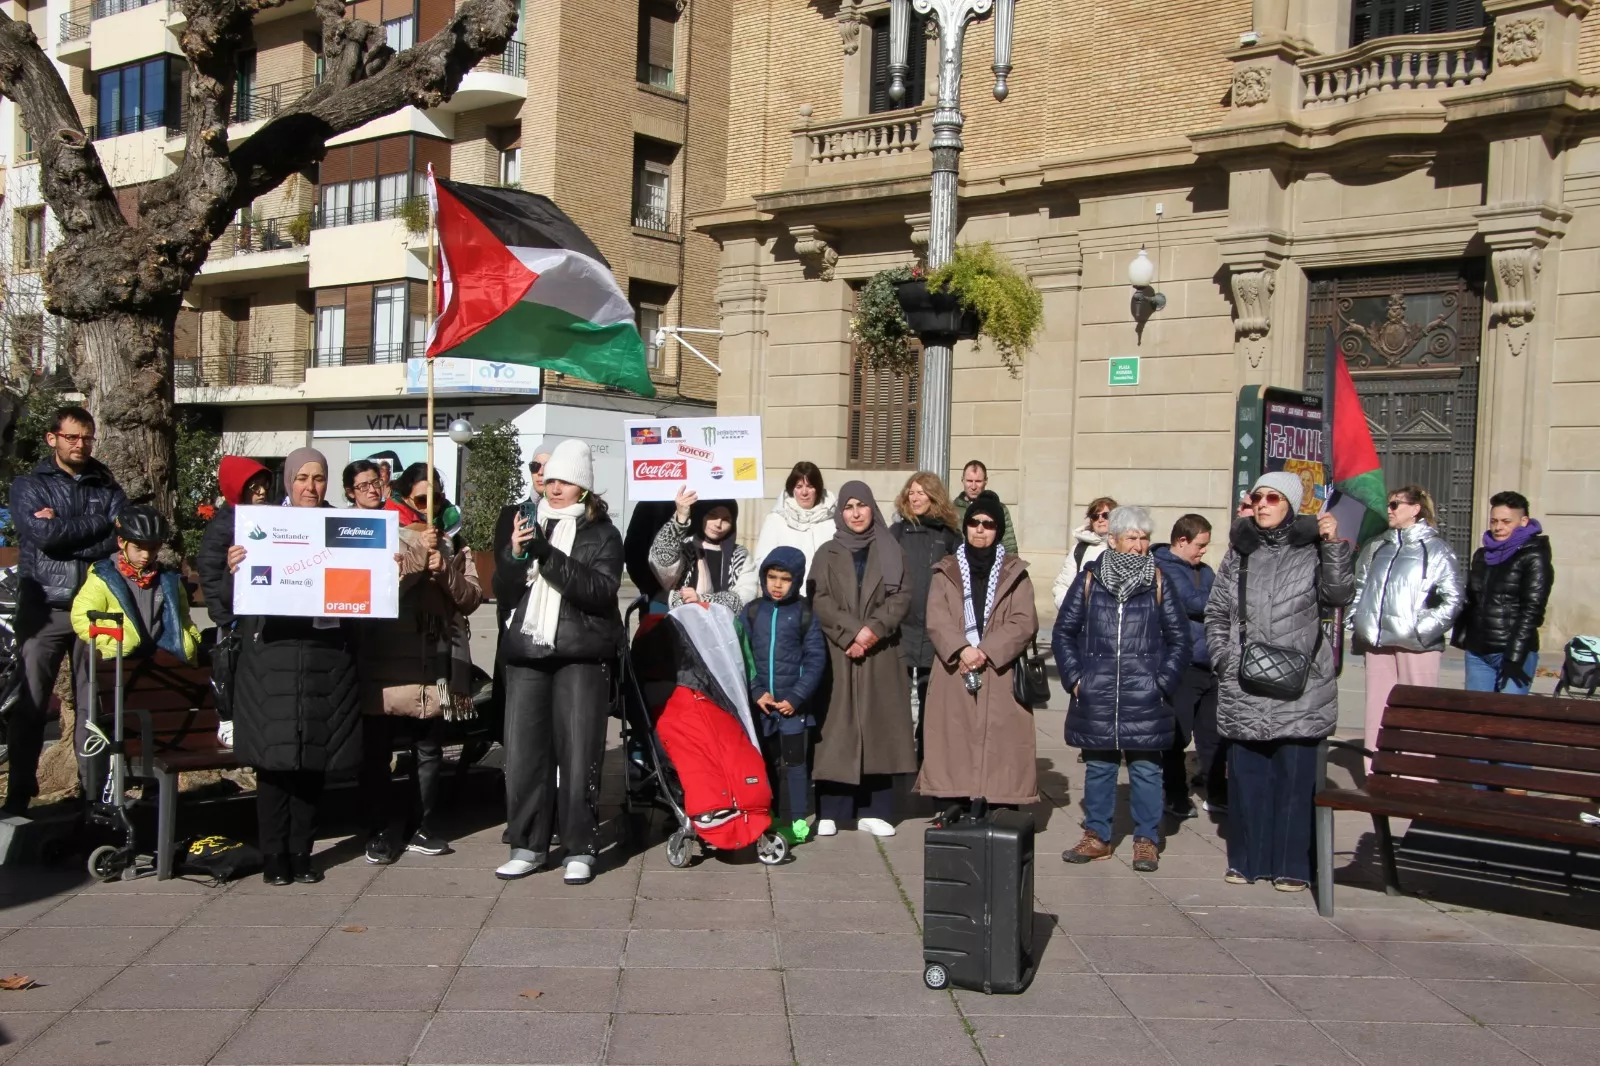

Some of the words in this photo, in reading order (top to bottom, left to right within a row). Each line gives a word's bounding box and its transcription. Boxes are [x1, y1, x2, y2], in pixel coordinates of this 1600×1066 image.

[1302, 395, 1319, 404] URBAN
[588, 443, 610, 454] cret
[679, 445, 711, 459] BOICOT
[272, 532, 310, 540] Santander
[251, 575, 269, 584] AXA
[279, 578, 303, 586] Allianz
[325, 601, 366, 613] orange
